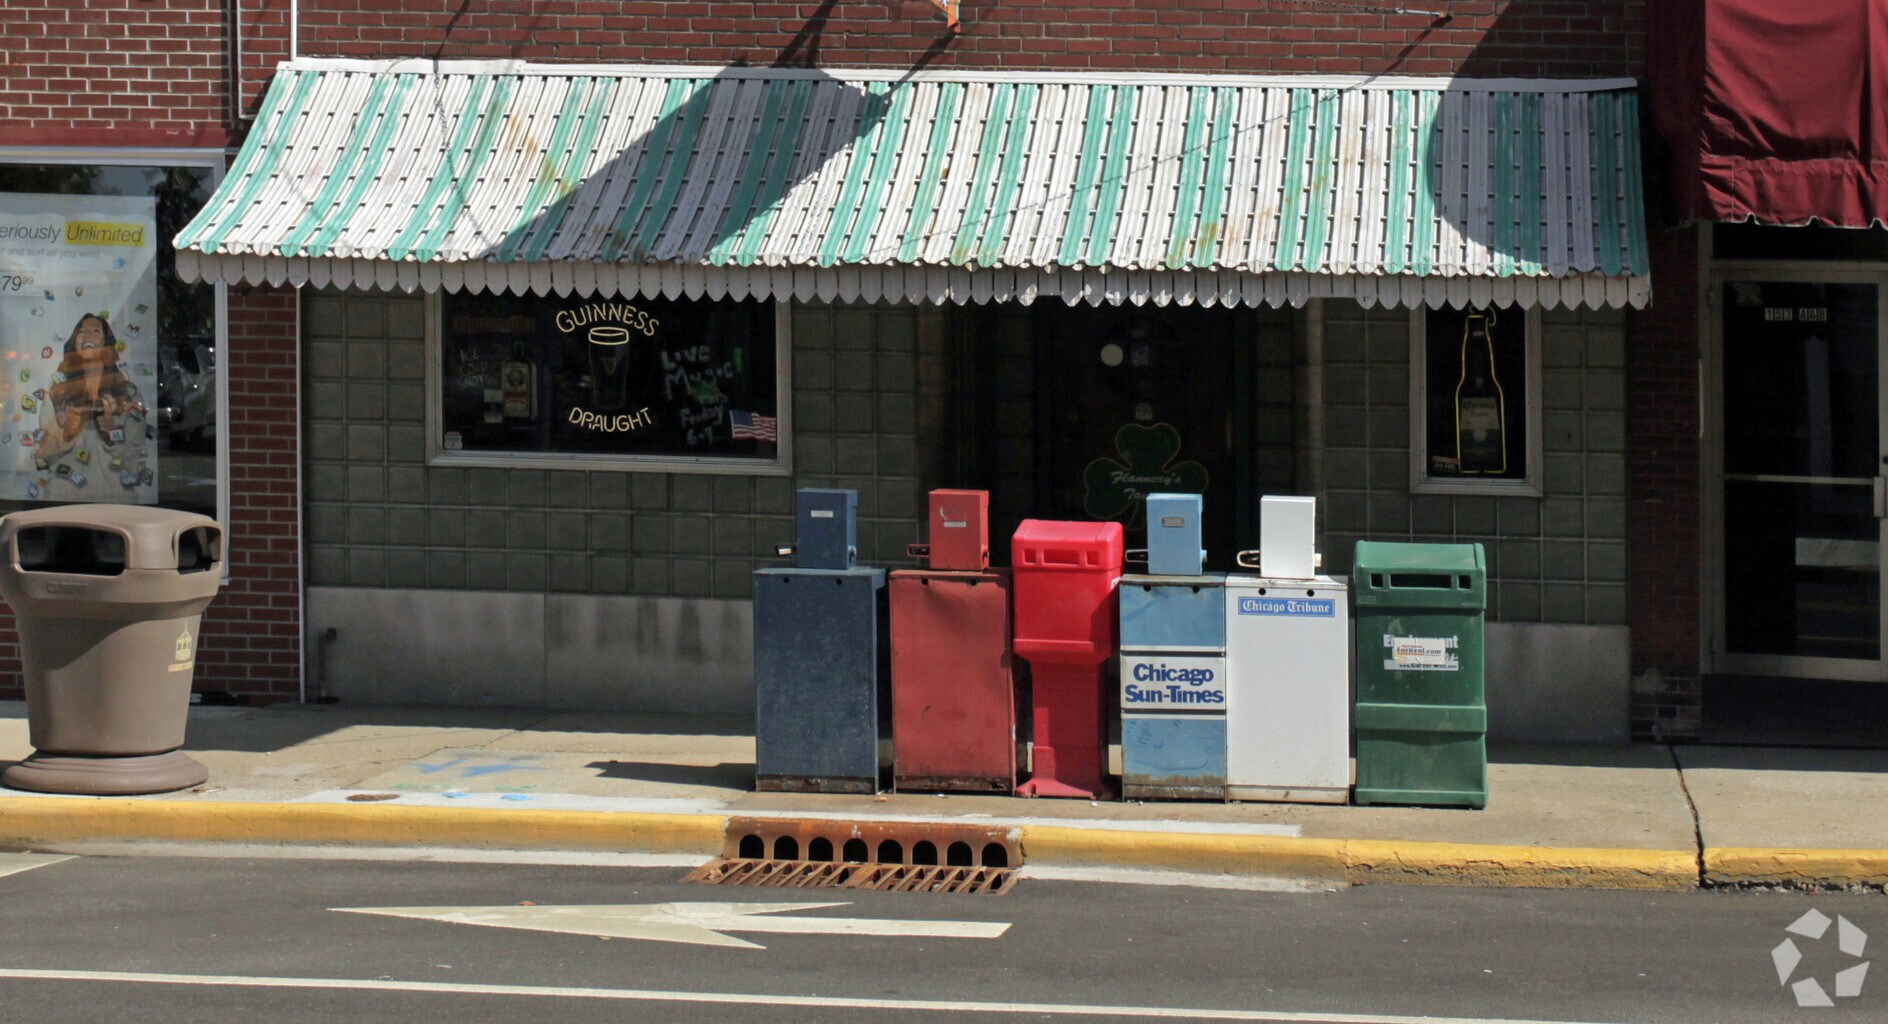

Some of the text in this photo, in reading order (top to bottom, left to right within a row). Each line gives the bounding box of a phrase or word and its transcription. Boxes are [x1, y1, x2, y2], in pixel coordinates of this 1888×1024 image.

[67, 224, 143, 244] Unlimited
[7, 247, 24, 256] and
[27, 247, 45, 256] surf
[59, 250, 77, 260] you
[79, 249, 101, 258] want
[556, 302, 660, 337] GUINNESS
[568, 406, 652, 433] DRAUGHT
[1110, 470, 1182, 486] Flannery's
[1242, 599, 1330, 614] Chicago Tribune
[1397, 646, 1441, 655] ForRent.com
[1133, 663, 1214, 686] Chicago
[1125, 684, 1224, 703] Sun-Times
